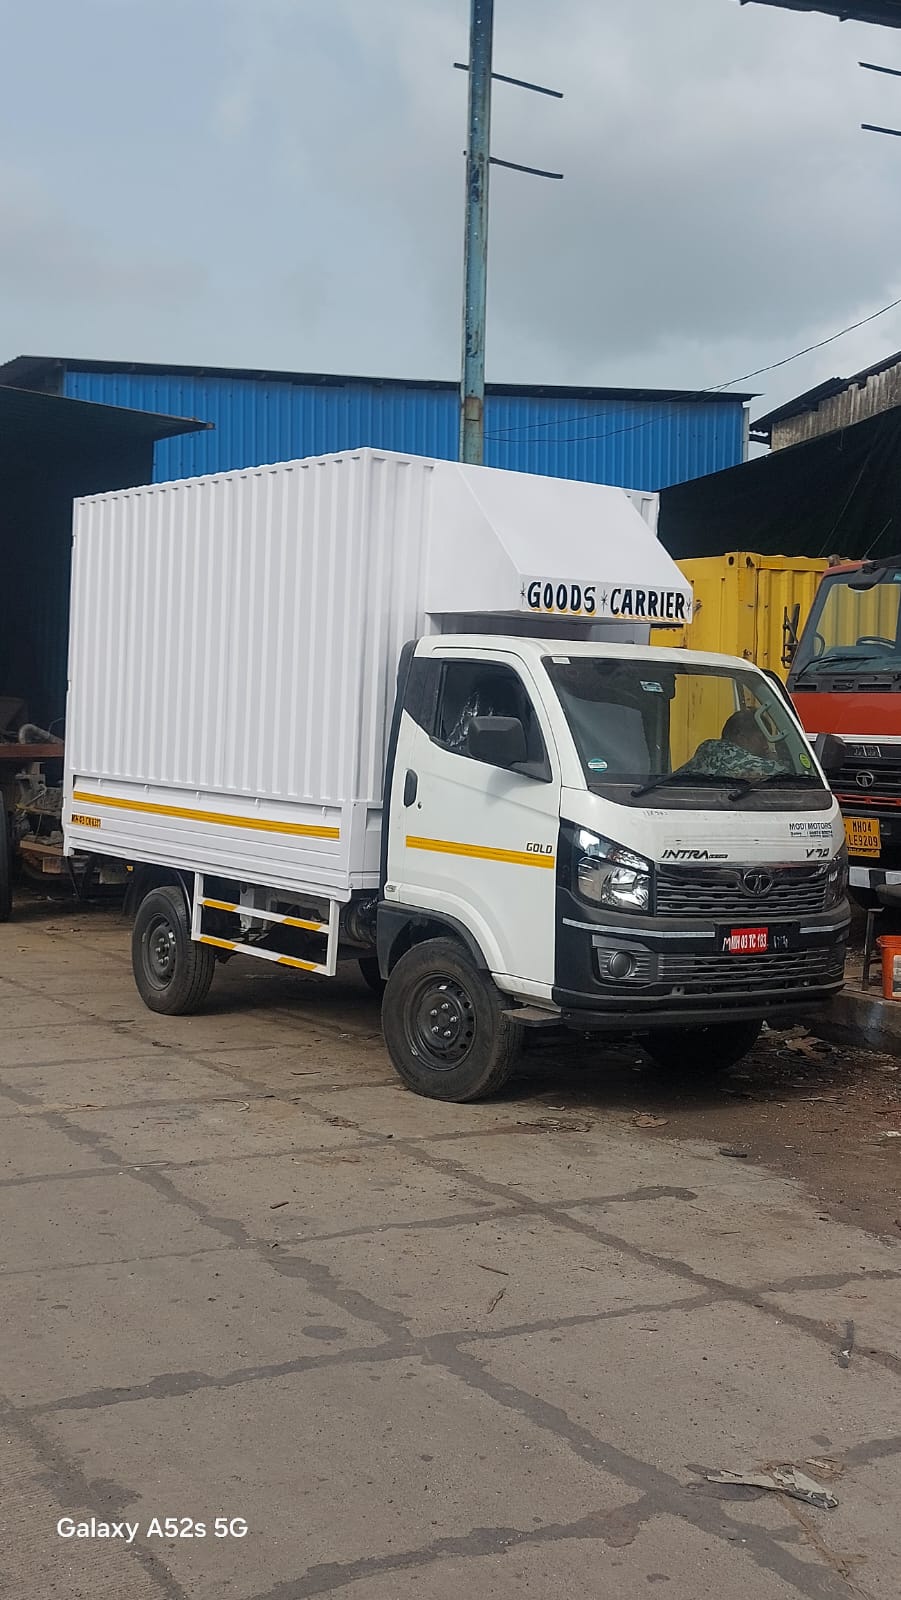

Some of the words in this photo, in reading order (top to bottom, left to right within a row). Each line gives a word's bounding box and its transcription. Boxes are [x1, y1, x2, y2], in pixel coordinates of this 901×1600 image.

[527, 581, 597, 614] GOODS
[610, 588, 687, 620] CARRIER
[808, 822, 832, 830] MOTORS
[852, 820, 872, 833] MH04
[848, 834, 878, 847] LE9209
[526, 842, 553, 854] GOLD
[661, 849, 709, 860] INTRA
[731, 935, 741, 949] MH
[741, 934, 748, 949] 03
[749, 933, 756, 948] TC
